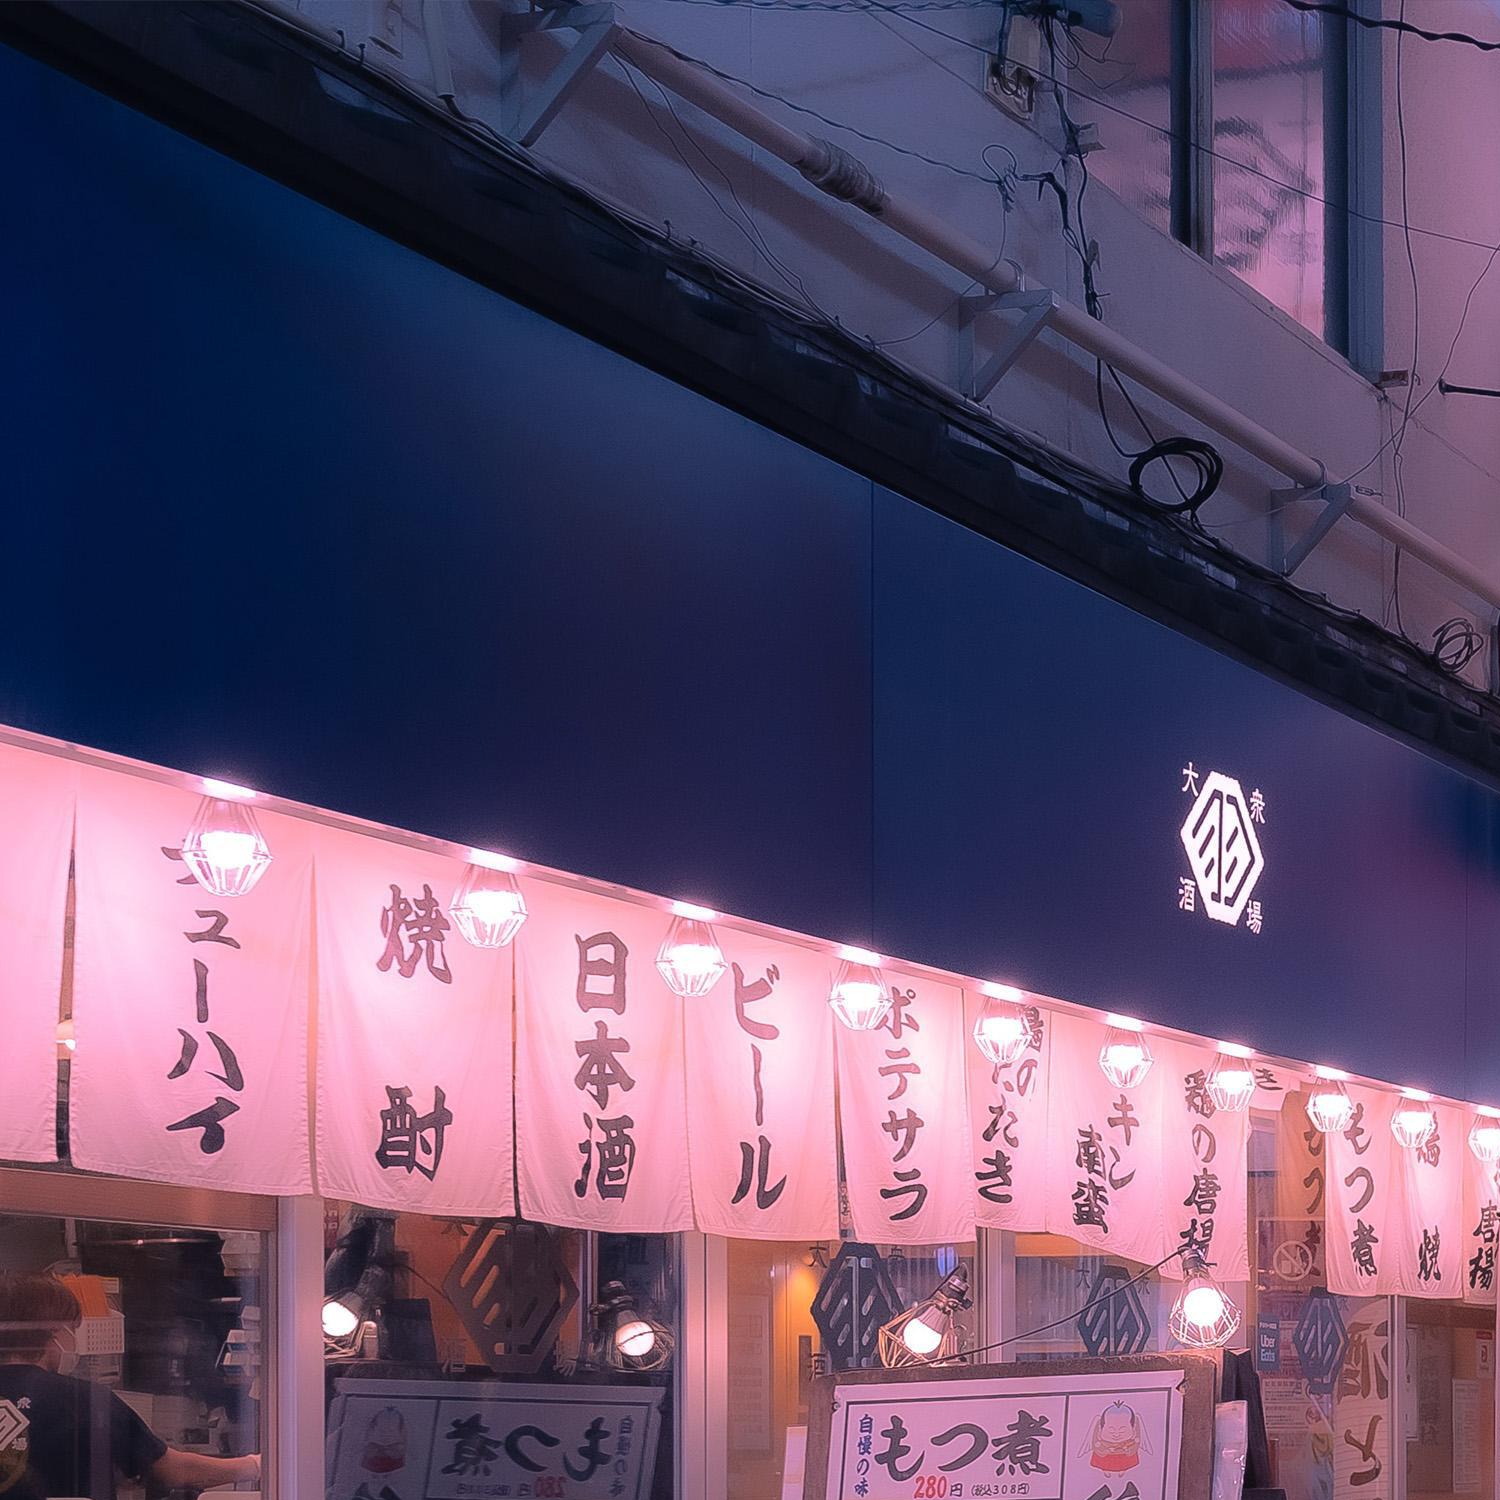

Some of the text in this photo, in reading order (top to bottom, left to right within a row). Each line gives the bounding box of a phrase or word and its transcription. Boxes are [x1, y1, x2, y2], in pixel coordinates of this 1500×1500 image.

[375, 883, 453, 1181] 焼酎
[574, 931, 636, 1202] 日本酒
[730, 961, 788, 1211] ビール
[877, 986, 930, 1221] ポテサラ
[1072, 1124, 1109, 1234] 南蛮
[1344, 1102, 1379, 1277] もつ煮
[1260, 1334, 1276, 1348] Uber
[854, 1413, 874, 1498] 自慢の味
[873, 1409, 1055, 1482] もつ煮
